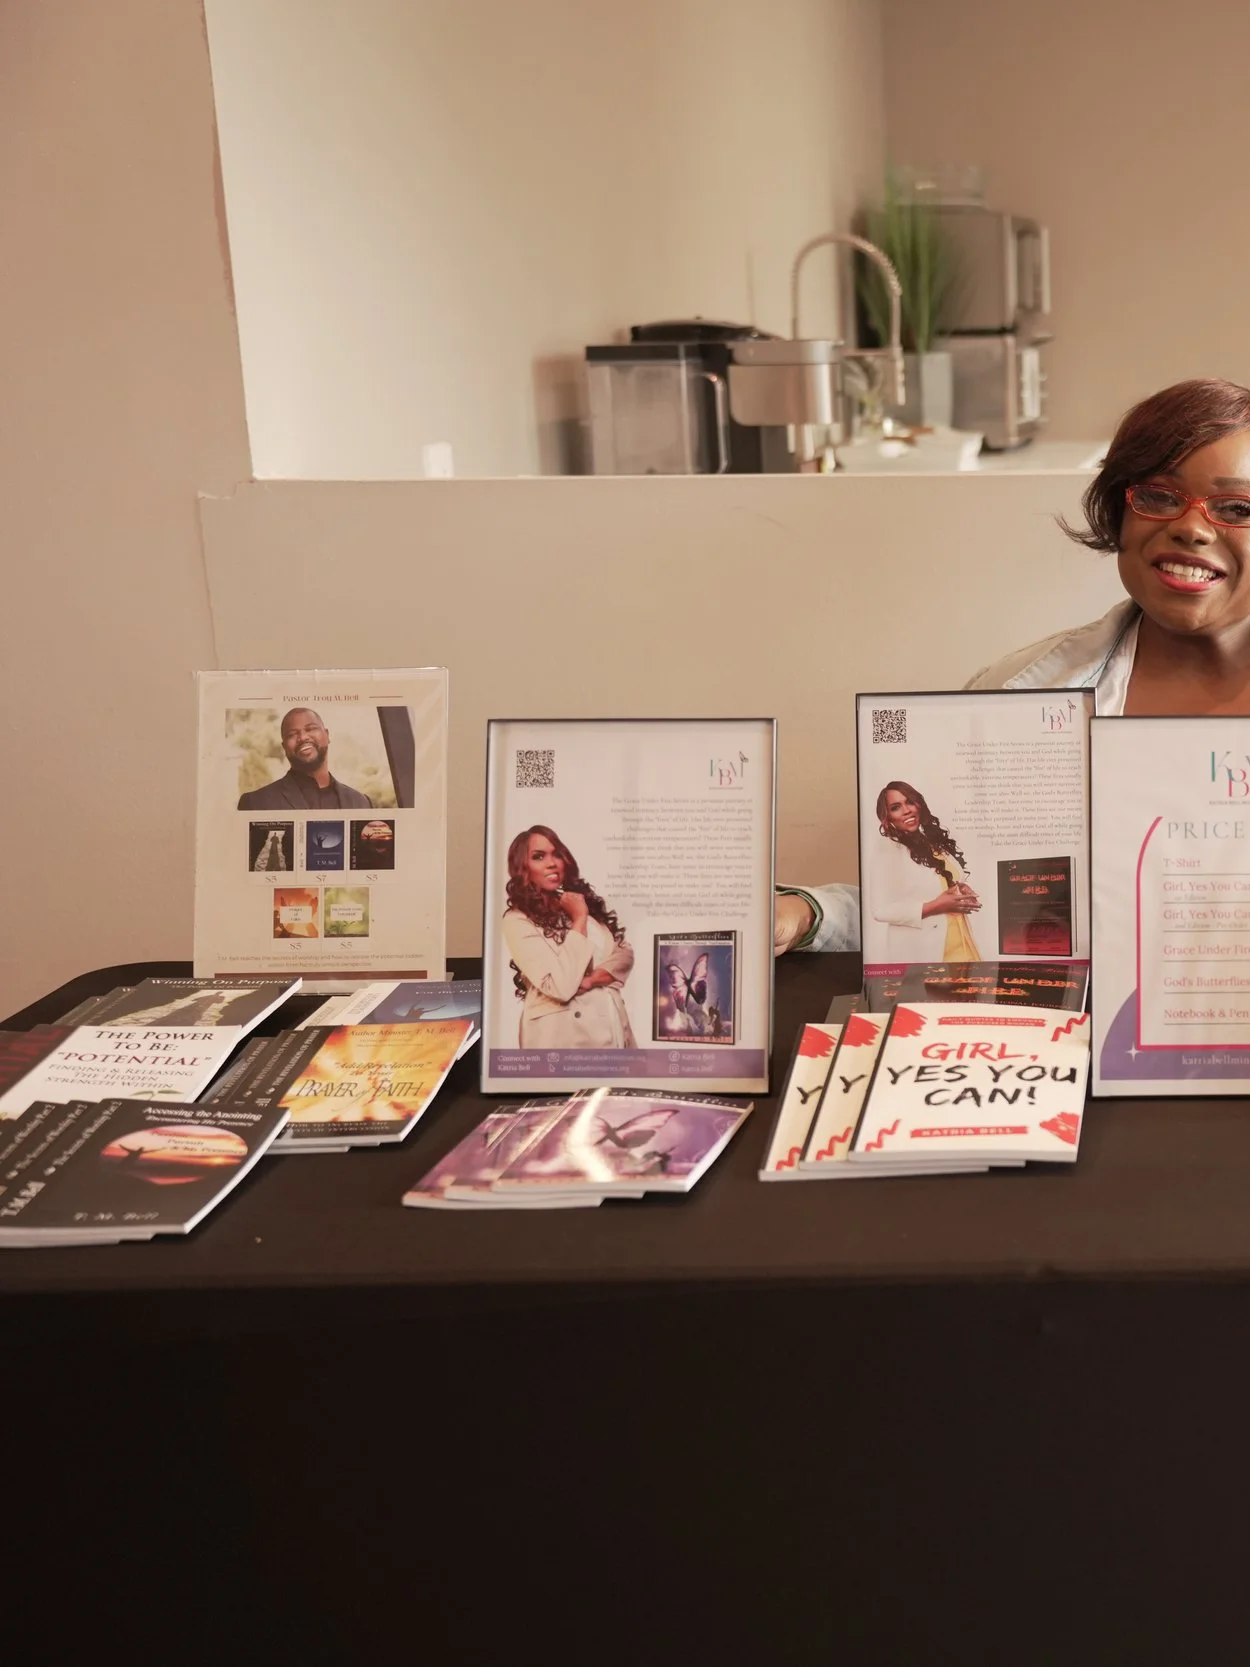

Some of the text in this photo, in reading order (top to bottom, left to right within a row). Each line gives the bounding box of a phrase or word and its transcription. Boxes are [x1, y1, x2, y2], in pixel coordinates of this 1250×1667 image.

[1168, 820, 1246, 839] PRICE
[1163, 857, 1201, 868] T-Shirt
[1188, 882, 1208, 892] Yes
[1210, 882, 1231, 892] You
[1188, 909, 1208, 919] Yes
[1210, 909, 1231, 919] You
[1164, 944, 1197, 956] Grace
[1198, 944, 1231, 955] Under
[237, 978, 293, 986] Purpose
[1164, 976, 1194, 987] God's
[1164, 1008, 1249, 1019] Notebook & Pen
[96, 1030, 214, 1041] THE POWER
[114, 1042, 179, 1052] TO BE:
[921, 1042, 1039, 1061] GIRL,
[525, 1054, 541, 1062] with
[48, 1063, 109, 1074] FINDING
[126, 1067, 197, 1077] RELEASING
[887, 1065, 1078, 1085] YES YOU
[101, 1073, 159, 1082] HIDDEN
[296, 1079, 358, 1097] PRAYER
[924, 1086, 1037, 1108] CAN!
[143, 1107, 263, 1121] Accessing the Anointing
[921, 1127, 1013, 1137] KATRIA BELL
